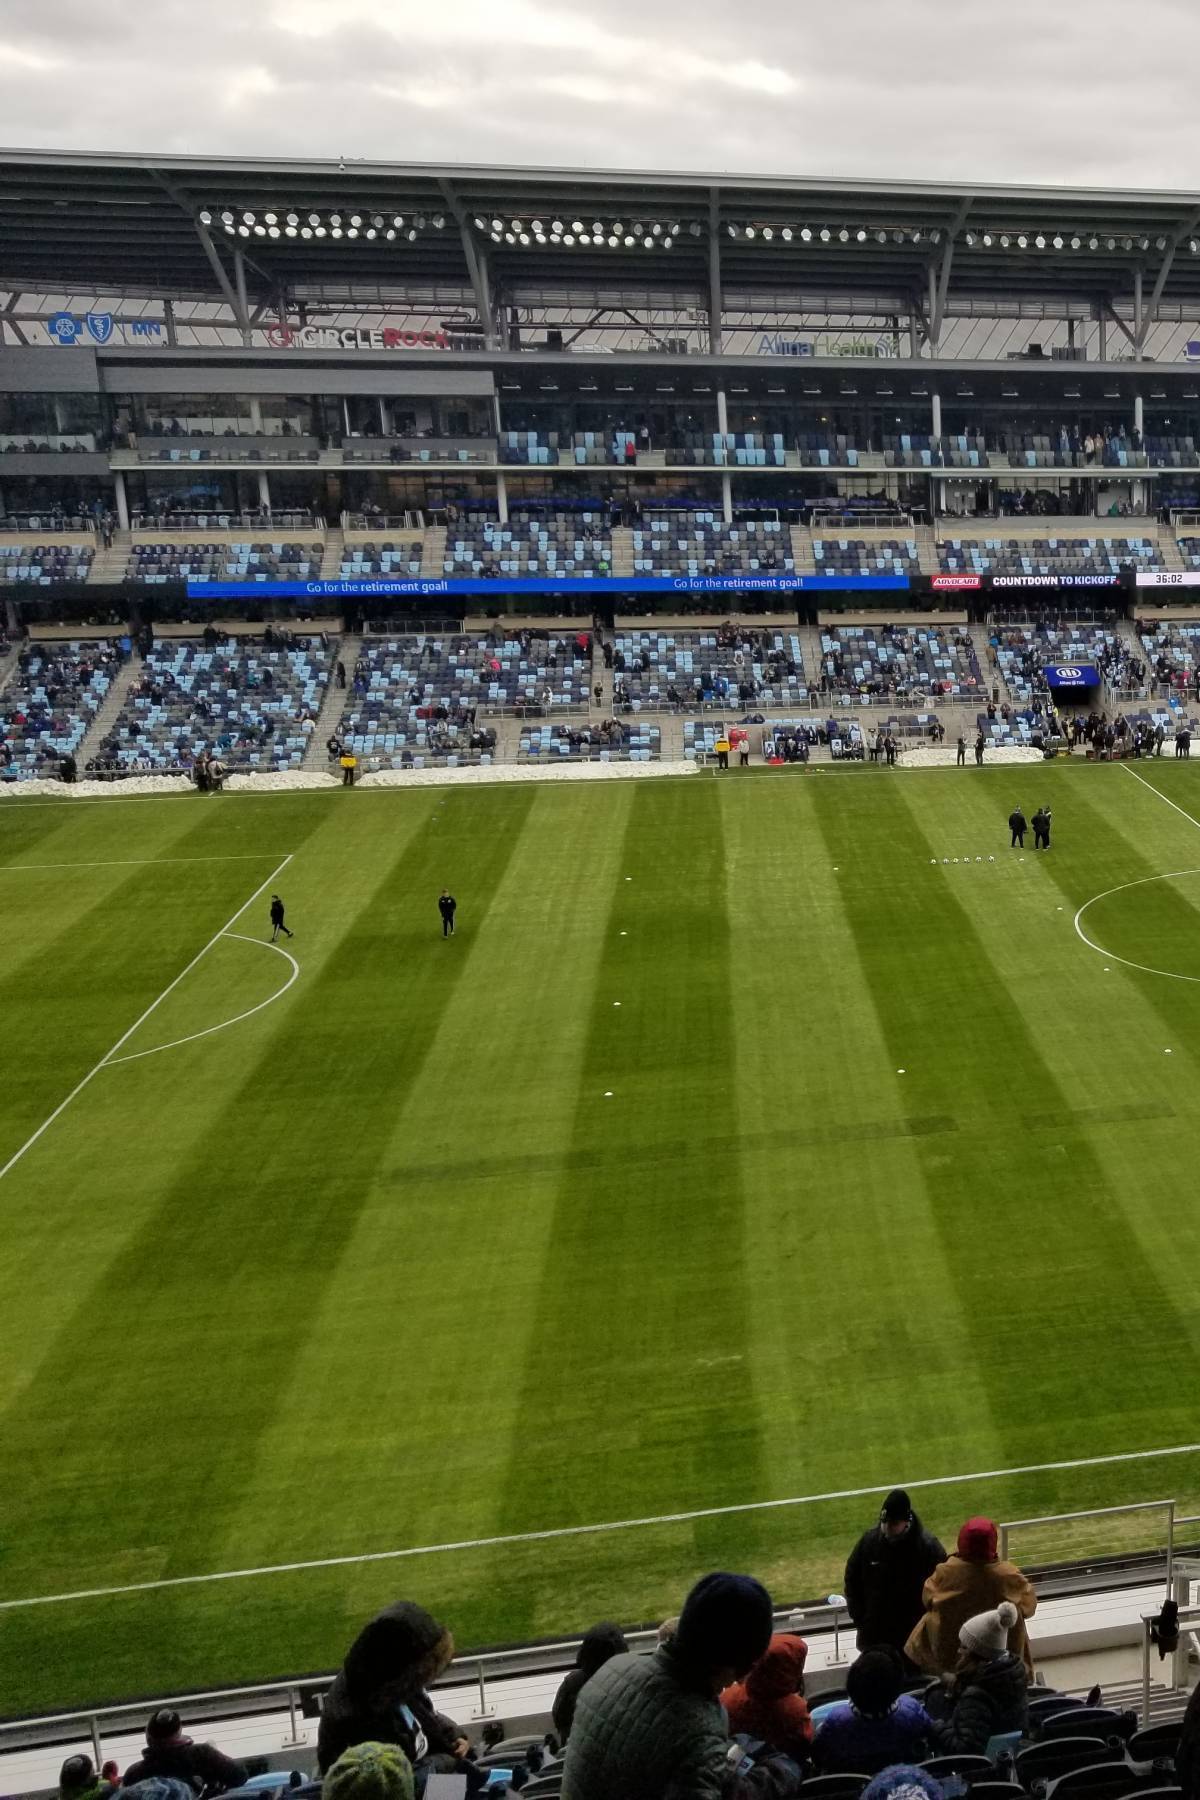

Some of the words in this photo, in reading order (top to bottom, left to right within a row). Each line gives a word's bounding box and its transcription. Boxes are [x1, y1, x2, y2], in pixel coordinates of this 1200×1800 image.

[132, 320, 161, 336] MN
[758, 334, 813, 356] Allina
[674, 579, 687, 588] Go
[690, 578, 703, 588] for
[706, 578, 721, 588] the
[723, 578, 777, 588] retirement
[993, 577, 1058, 586] COUNTDOWN
[1060, 577, 1073, 585] TO
[1156, 574, 1182, 583] 36:02
[307, 582, 321, 592] Go
[324, 582, 338, 592] for
[341, 582, 359, 592] the
[360, 581, 419, 592] retirement
